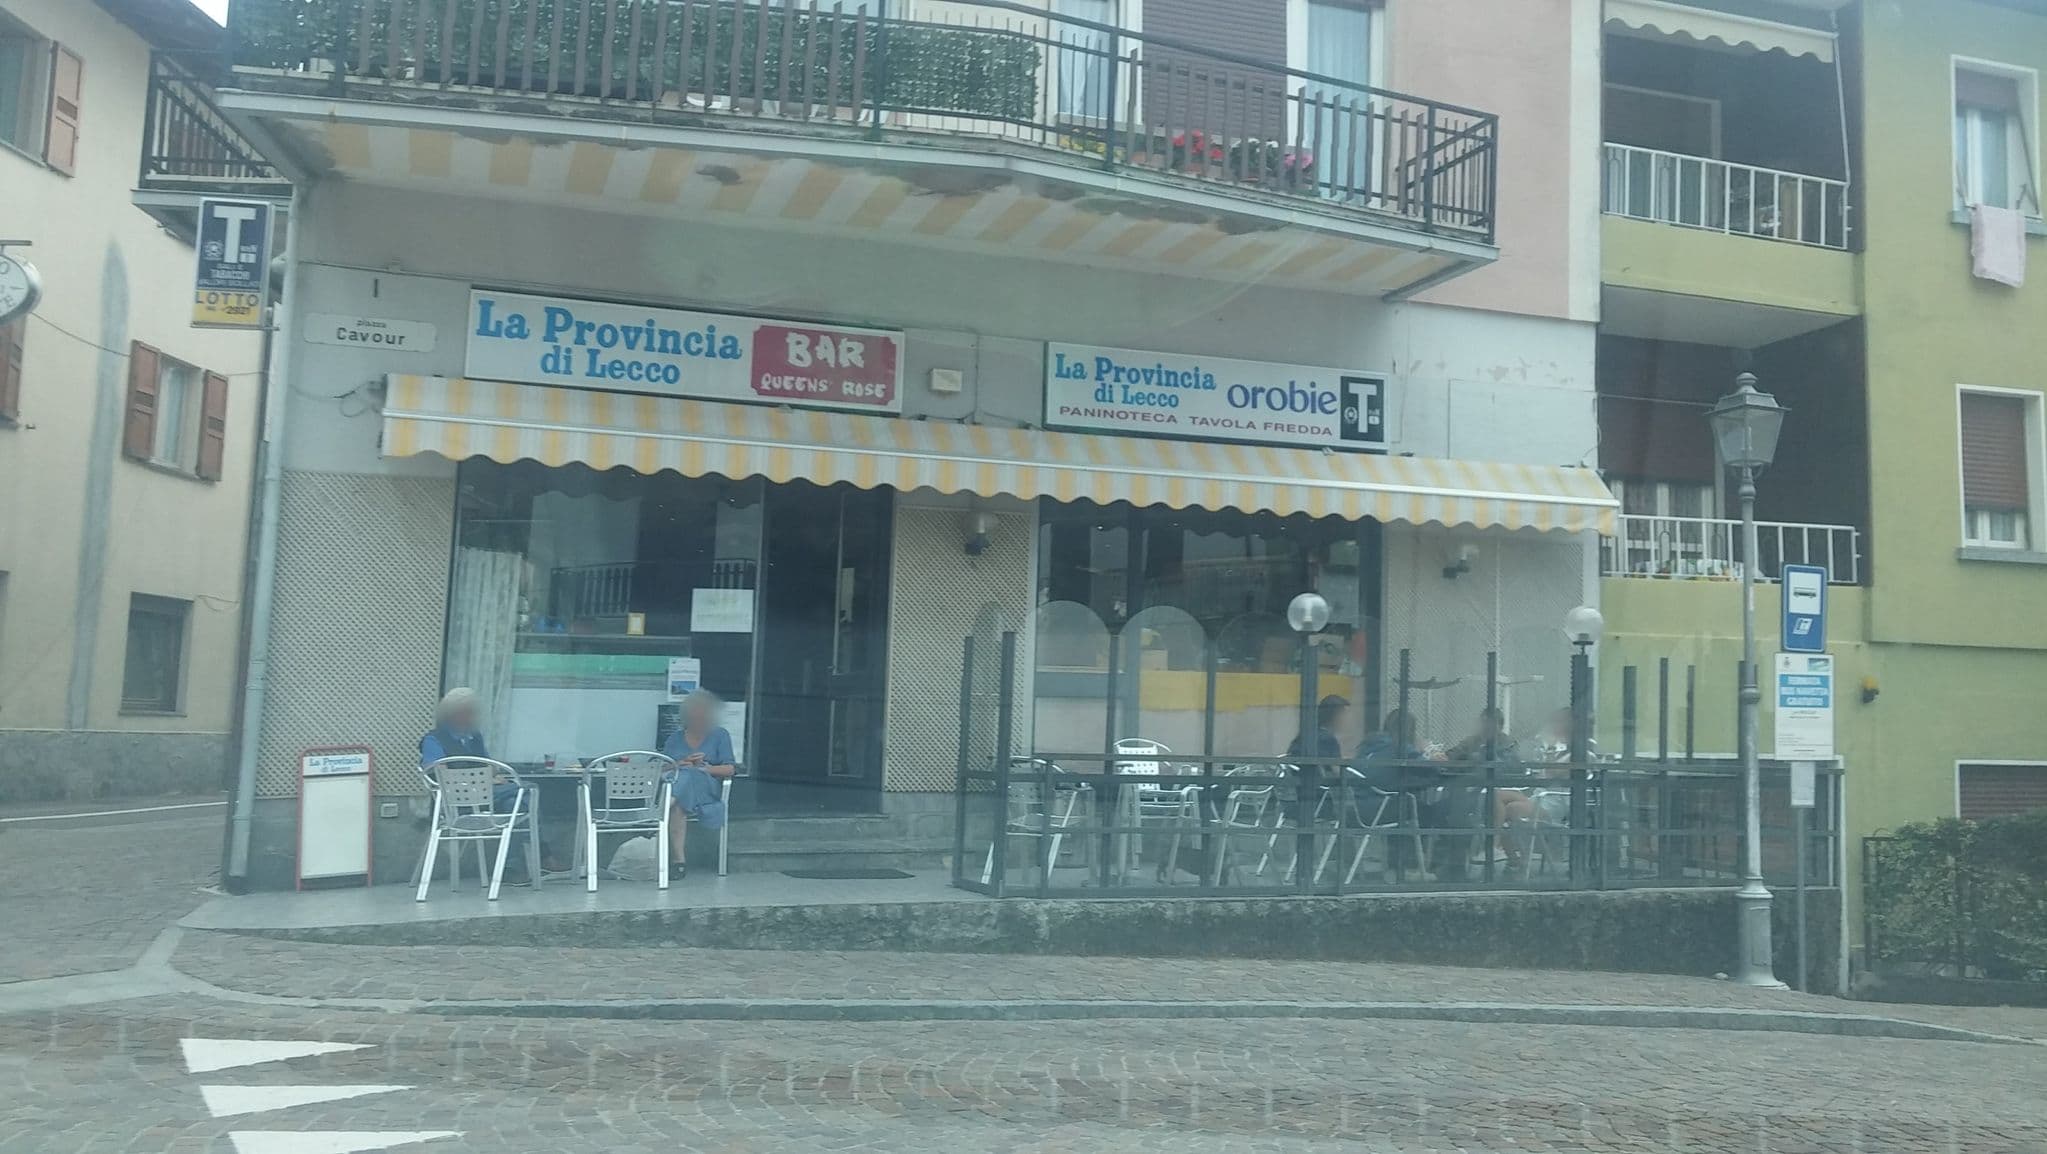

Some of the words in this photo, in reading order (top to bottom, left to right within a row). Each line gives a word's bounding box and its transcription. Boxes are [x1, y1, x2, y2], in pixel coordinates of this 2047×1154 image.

[195, 291, 260, 307] LOTTO
[336, 326, 406, 346] Cavour
[476, 300, 531, 340] La
[543, 306, 743, 360] Provincia
[540, 345, 574, 376] di
[585, 348, 681, 385] Lecco
[786, 331, 865, 369] BAR
[760, 372, 829, 393] QUEENS
[841, 380, 887, 399] ROSE
[1055, 353, 1088, 381] La
[1095, 356, 1217, 391] Provincia
[1094, 382, 1115, 403] di
[1121, 384, 1180, 408] Lecco
[1226, 380, 1338, 415] orobie
[1059, 405, 1178, 425] PANINOTECA
[1188, 415, 1257, 431] TAVOLA
[1263, 421, 1334, 438] FREDDA
